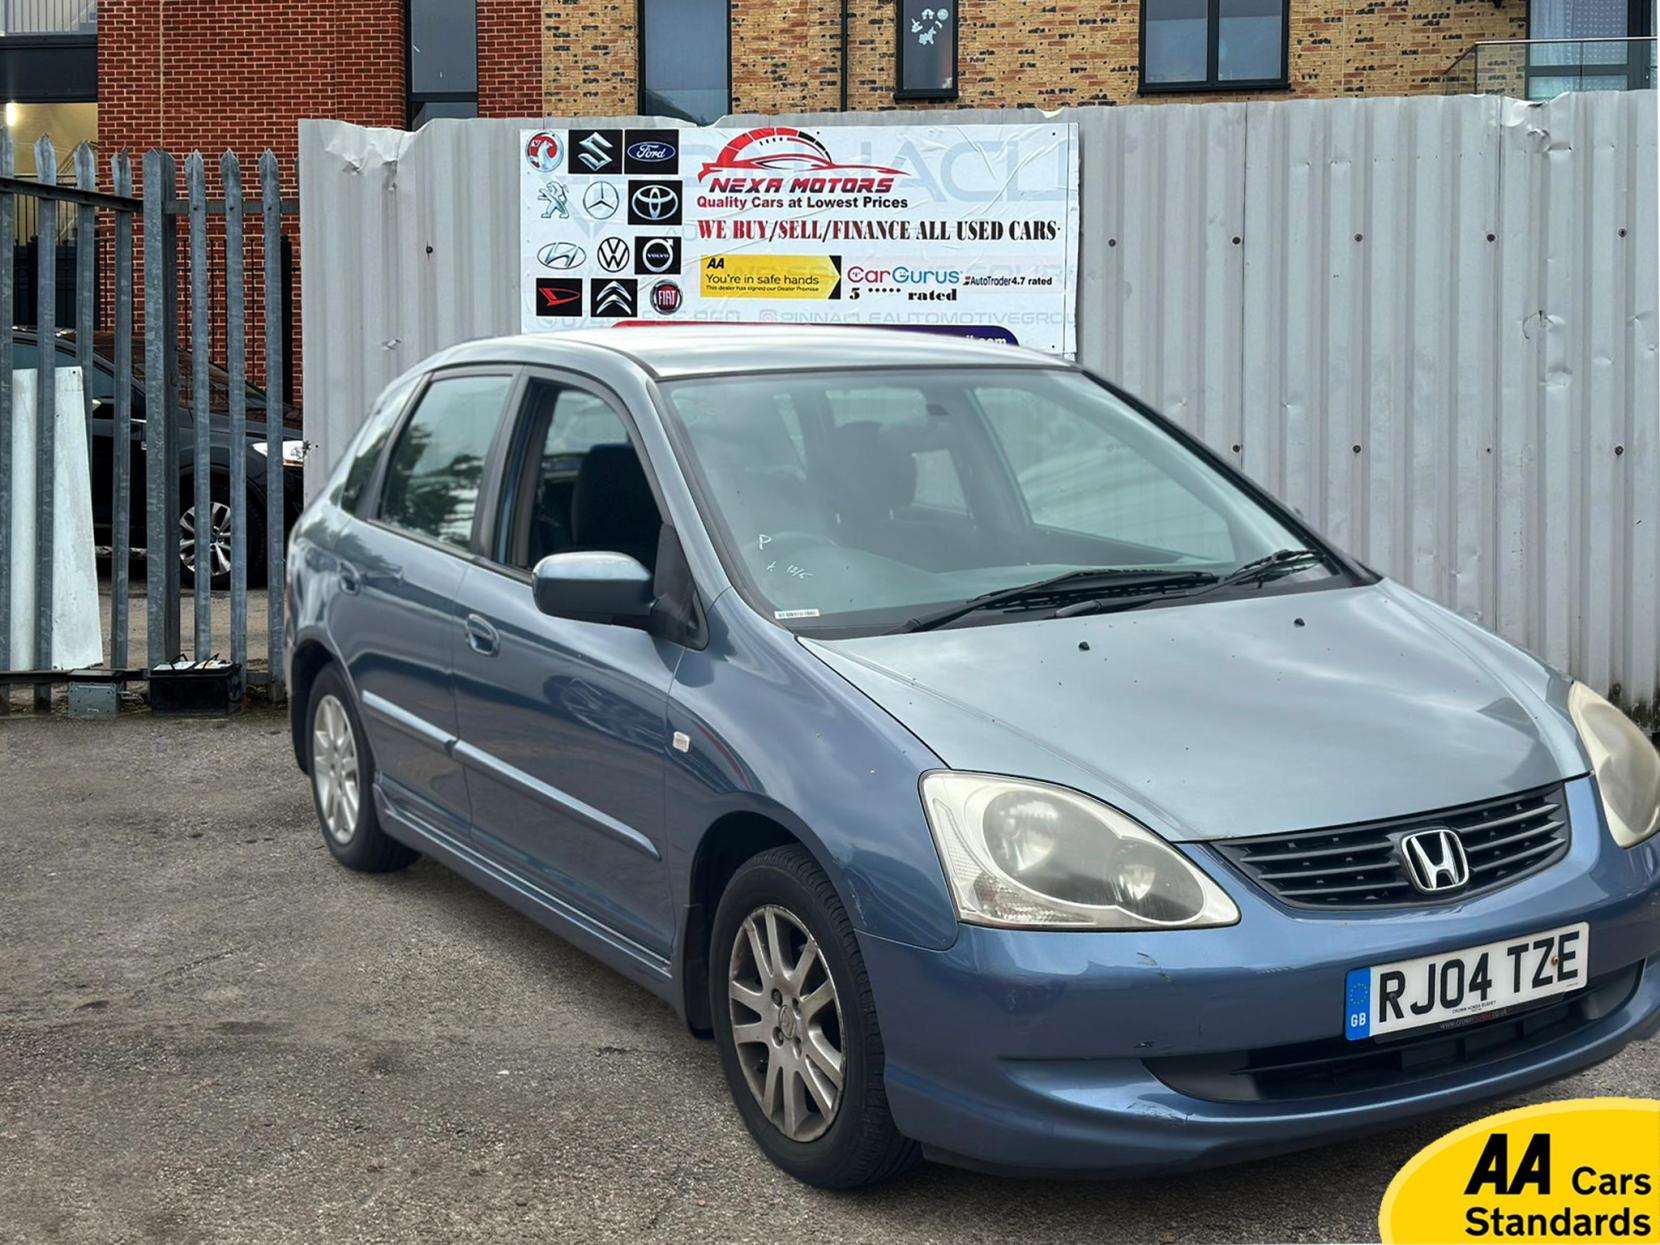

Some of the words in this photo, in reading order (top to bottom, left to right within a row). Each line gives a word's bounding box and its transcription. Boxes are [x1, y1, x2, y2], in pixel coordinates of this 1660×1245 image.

[636, 143, 667, 159] Ford
[709, 177, 784, 194] NEXA
[789, 177, 895, 194] MOTORS
[697, 196, 748, 210] Quality
[751, 196, 784, 209] Cars
[788, 197, 803, 209] at
[807, 196, 859, 209] Lowest
[863, 196, 908, 209] Prices
[697, 219, 727, 240] WE
[915, 220, 951, 241] ALL
[956, 220, 1004, 241] USED
[1008, 220, 1057, 241] CARS
[706, 257, 725, 269] AA
[705, 273, 741, 285] You're
[744, 274, 754, 284] in
[757, 274, 781, 285] safe
[783, 274, 820, 285] hands
[847, 265, 960, 284] CarGurus
[1027, 277, 1053, 287] rated
[658, 290, 677, 306] FIAT
[849, 287, 861, 301] 5
[908, 288, 958, 302] rated
[1350, 1012, 1367, 1028] GB
[1379, 951, 1493, 1023] RJ04
[1507, 930, 1580, 994] TZE
